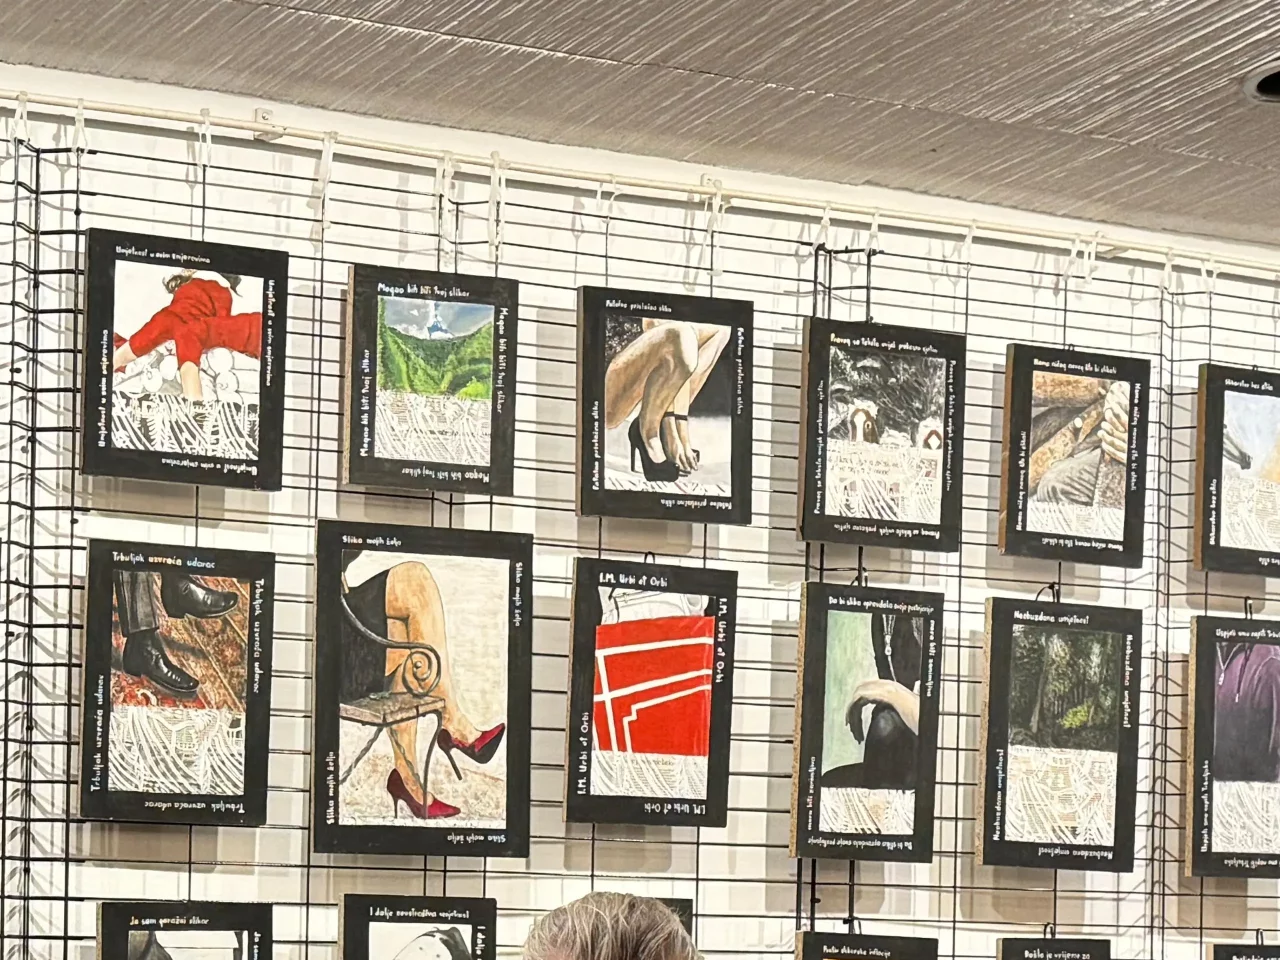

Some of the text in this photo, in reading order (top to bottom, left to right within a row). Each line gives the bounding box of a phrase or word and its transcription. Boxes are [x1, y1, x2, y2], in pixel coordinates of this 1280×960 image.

[495, 307, 509, 335] Mogao
[498, 338, 508, 352] bih
[498, 354, 507, 370] biti
[112, 551, 145, 565] Trbuljak
[186, 556, 216, 569] udarac
[717, 620, 727, 643] Urbi
[715, 660, 725, 683] Orbi
[141, 918, 157, 926] sam
[1045, 951, 1053, 960] je
